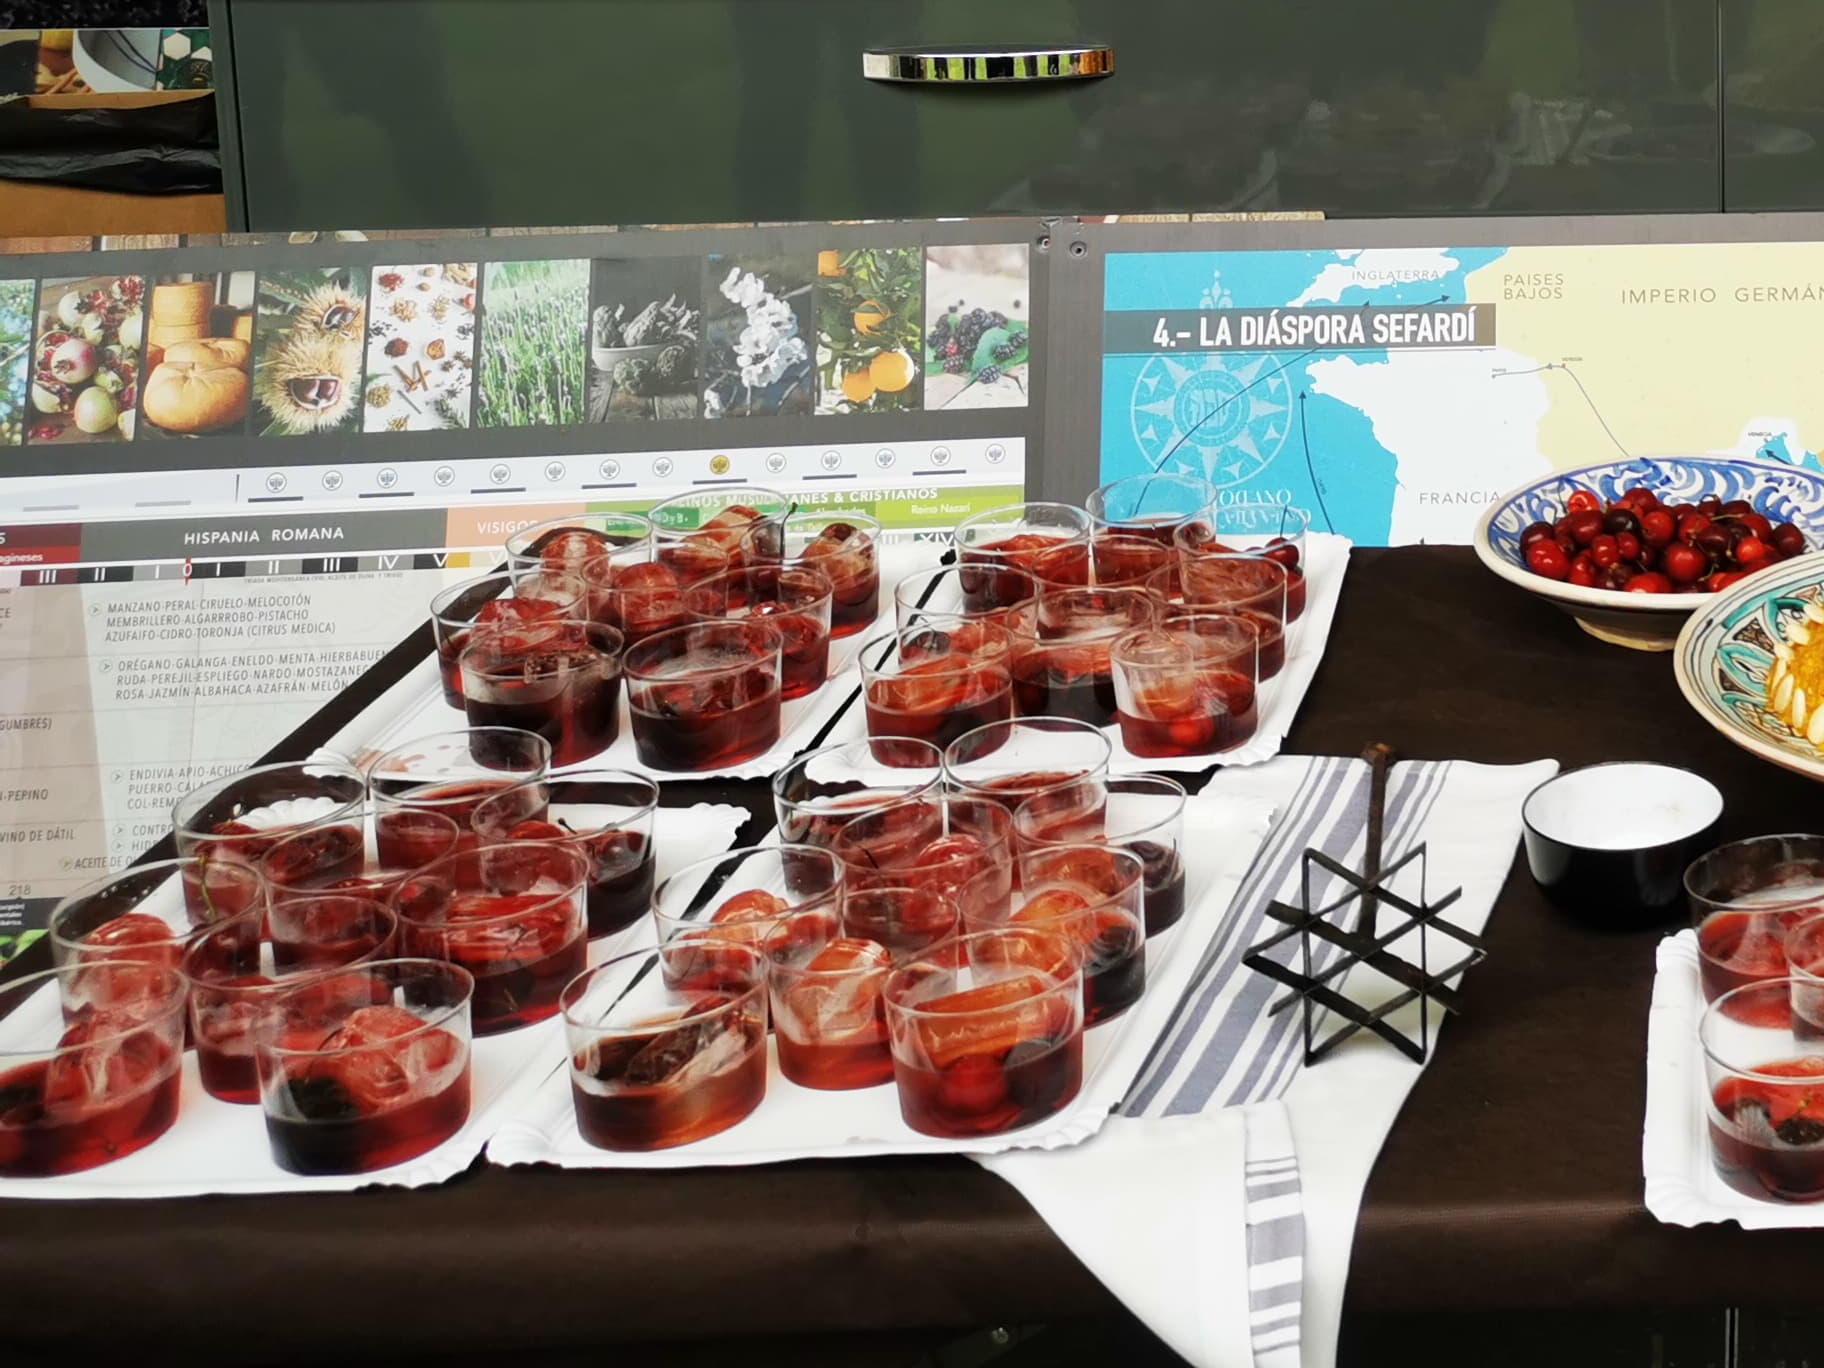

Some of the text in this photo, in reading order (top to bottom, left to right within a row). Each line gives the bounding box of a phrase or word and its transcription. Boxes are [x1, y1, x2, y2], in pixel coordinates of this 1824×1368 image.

[1351, 269, 1440, 282] INGLATERRA
[1503, 273, 1565, 287] PAISES
[1503, 286, 1564, 300] BAJOS
[1621, 287, 1717, 305] IMPERIO
[1153, 306, 1476, 347] 4.- LA DIÁSPORA SEFARDÍ
[833, 488, 938, 503] & CRISTIANOS
[1419, 491, 1500, 505] FRANCIA
[911, 502, 970, 515] Reino Nazarí
[184, 527, 344, 545] HISPANIA ROMANA
[322, 554, 400, 573] III IV
[29, 830, 43, 842] DE
[47, 825, 75, 841] DÁTIL
[9, 885, 31, 896] 218
